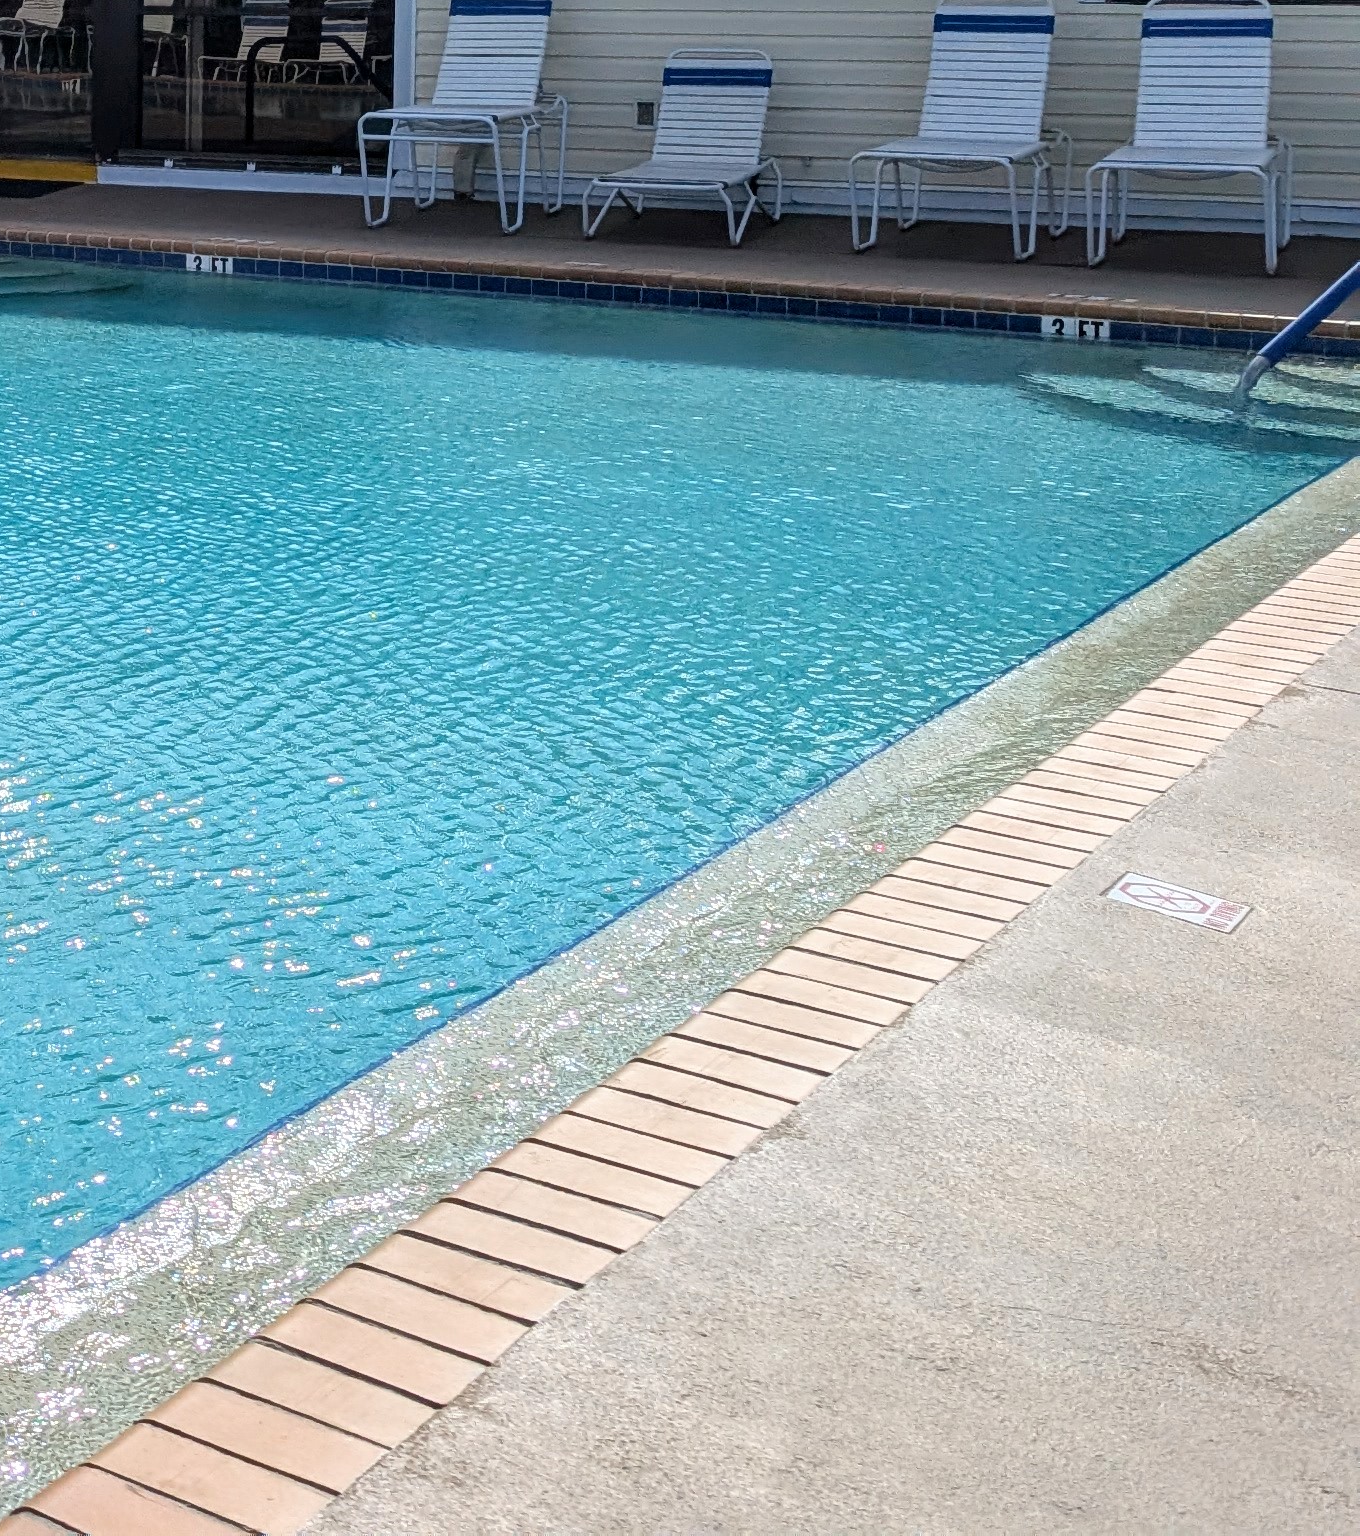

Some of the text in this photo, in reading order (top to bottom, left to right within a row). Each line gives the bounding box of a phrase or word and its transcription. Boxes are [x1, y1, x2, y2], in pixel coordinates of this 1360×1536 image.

[211, 258, 228, 272] FT
[1051, 318, 1104, 339] 3 FT
